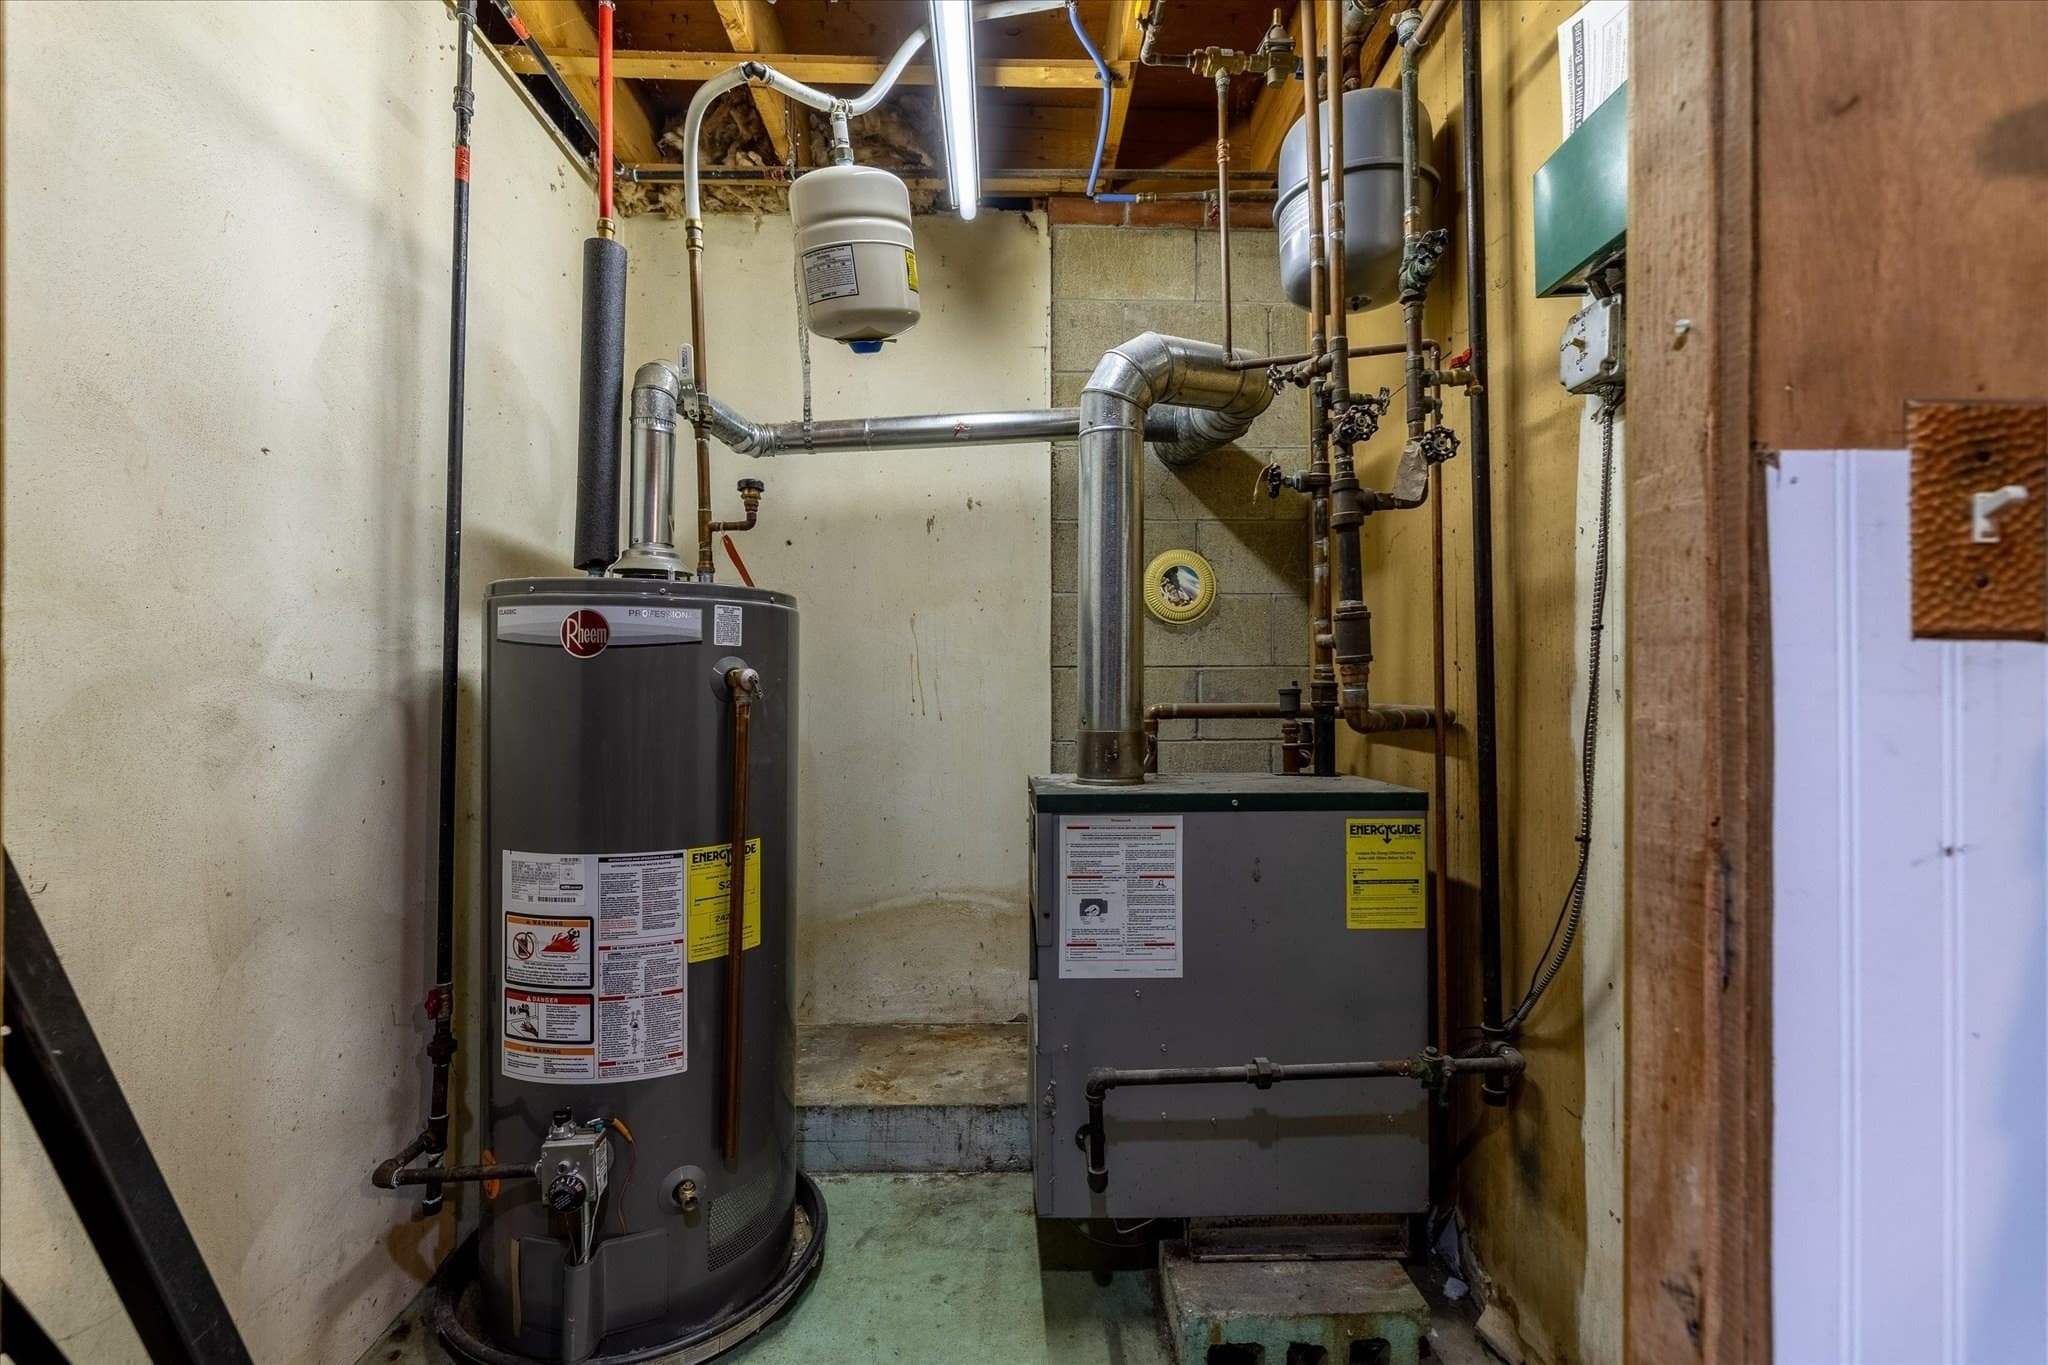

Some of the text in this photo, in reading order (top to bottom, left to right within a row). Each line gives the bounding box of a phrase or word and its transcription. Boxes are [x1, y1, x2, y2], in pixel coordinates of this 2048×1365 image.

[1574, 22, 1583, 63] BOILERS
[1575, 63, 1584, 85] GAS
[566, 607, 607, 650] Rheem
[1350, 824, 1422, 836] ENERGYGUIDE
[534, 919, 563, 927] WARNING
